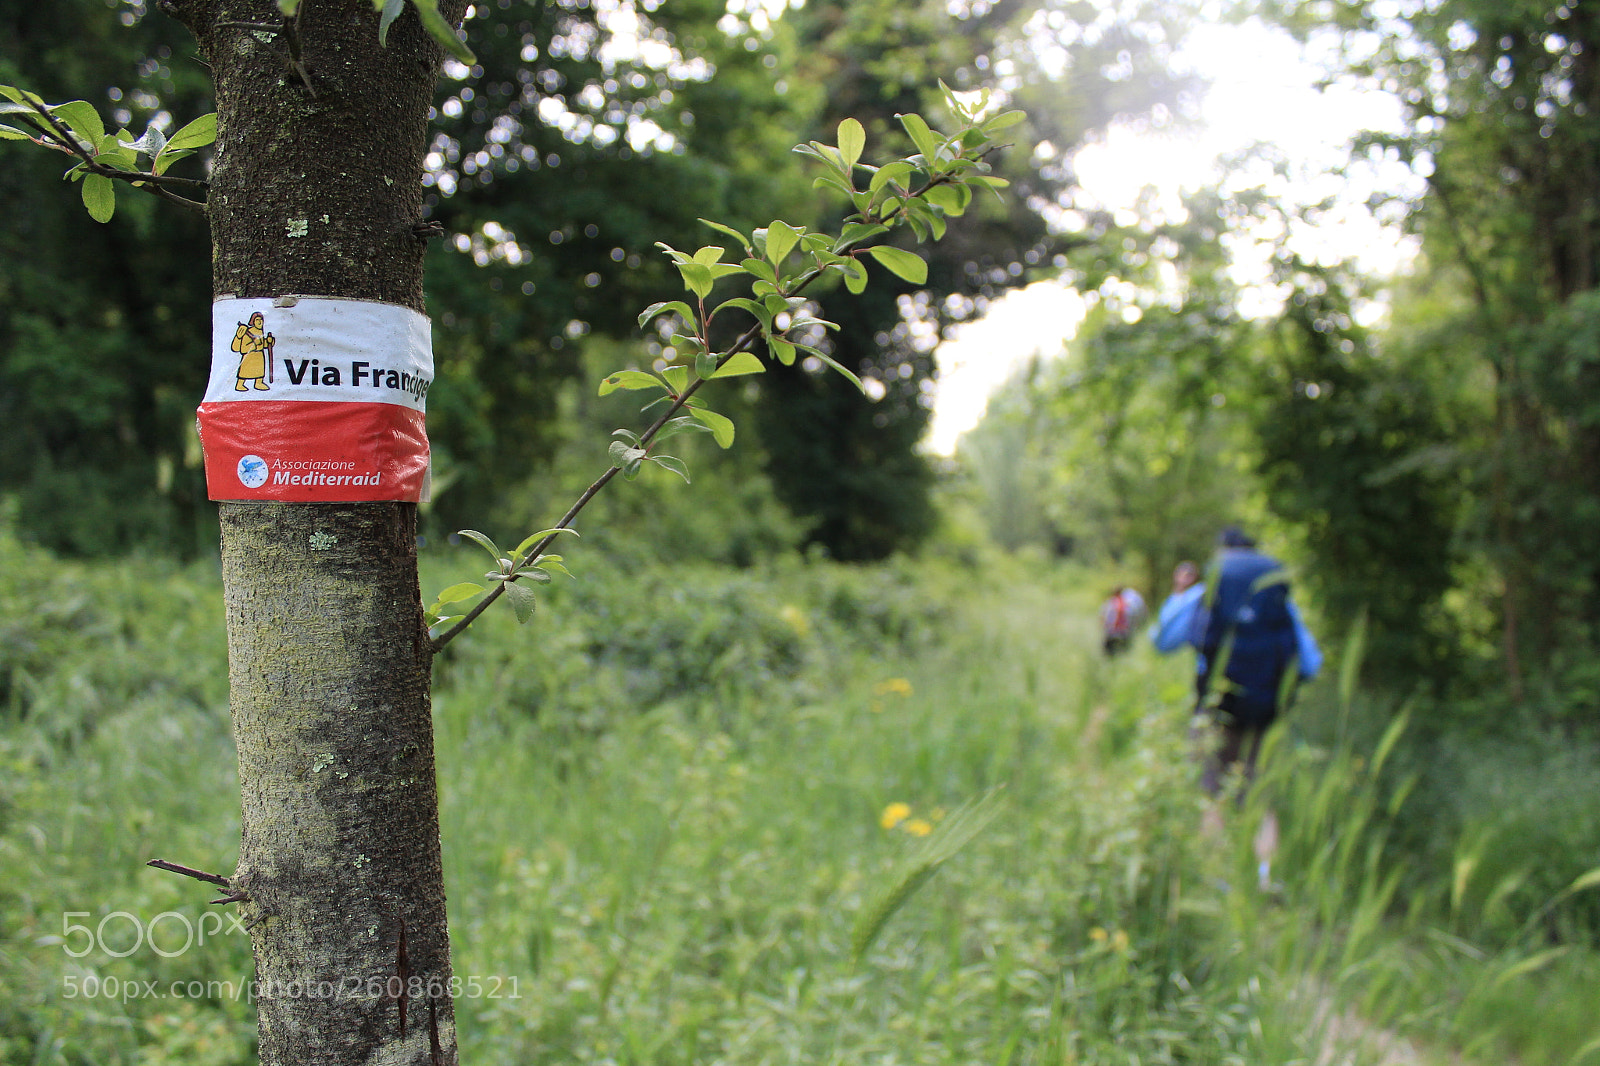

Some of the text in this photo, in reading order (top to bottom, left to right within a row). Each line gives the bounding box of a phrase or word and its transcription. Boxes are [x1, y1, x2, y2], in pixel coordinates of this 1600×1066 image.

[284, 359, 341, 386] Via
[272, 458, 356, 471] Associazione
[272, 471, 382, 487] Mediterraid
